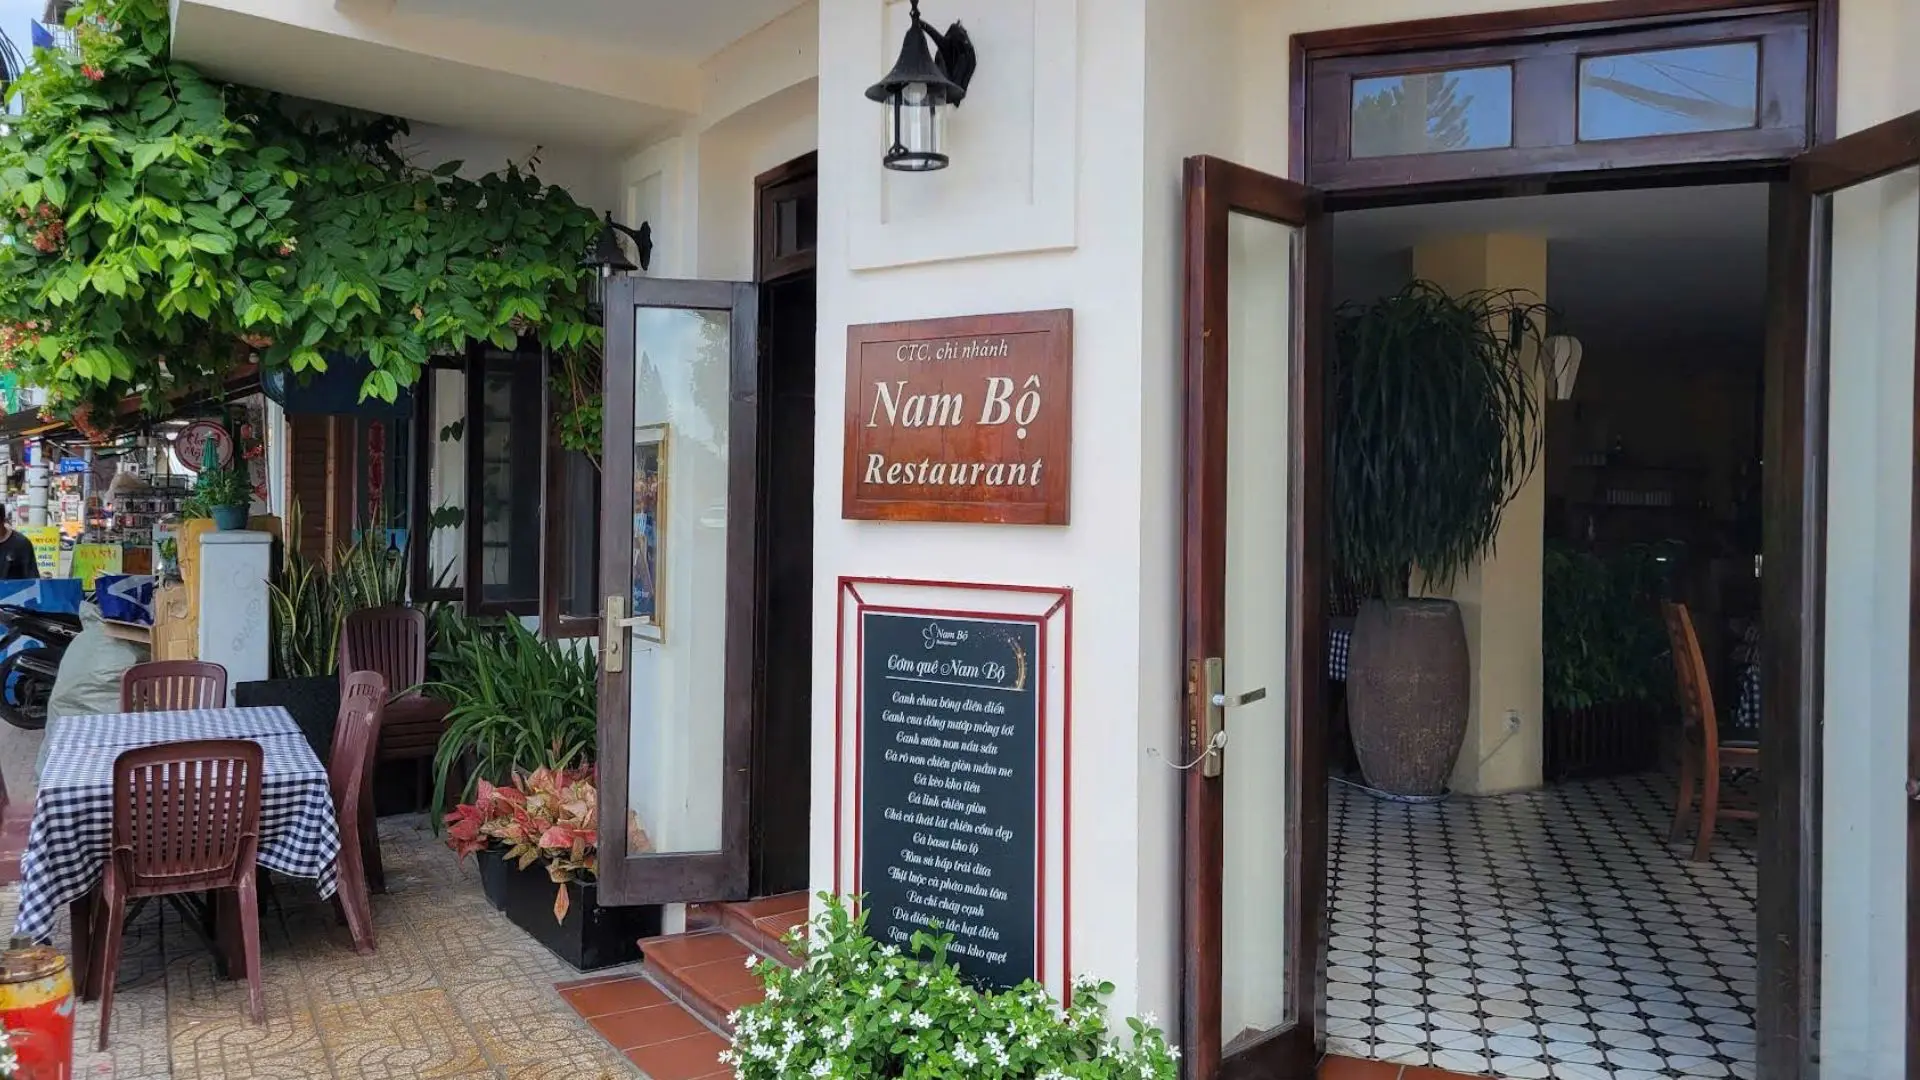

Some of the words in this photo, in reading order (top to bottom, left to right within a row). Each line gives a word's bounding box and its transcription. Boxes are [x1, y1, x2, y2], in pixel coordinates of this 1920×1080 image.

[897, 343, 932, 362] CTC,
[936, 342, 958, 360] chi
[962, 339, 1008, 358] nhánh
[866, 380, 964, 428] Nam
[977, 374, 1041, 439] Bộ
[864, 454, 1042, 486] Restaurant
[937, 628, 955, 639] Nam
[888, 654, 914, 671] Cơm
[916, 660, 938, 676] quê
[941, 659, 979, 678] Nam
[982, 662, 1005, 683] Bộ
[892, 691, 915, 705] Canh
[916, 695, 937, 707] chua
[939, 697, 961, 713] bông
[882, 710, 905, 723] Canh
[906, 714, 921, 725] cua
[896, 731, 919, 745] Canh
[943, 741, 959, 750] non
[885, 749, 897, 762] Cá
[910, 755, 925, 765] non
[927, 756, 950, 769] chiên
[998, 768, 1013, 777] me
[914, 773, 926, 785] Cá
[928, 775, 943, 786] kèo
[945, 778, 961, 790] kho
[908, 791, 920, 804] Cá
[922, 794, 939, 807] linh
[941, 798, 964, 811] chiên
[904, 811, 914, 823] cá
[950, 818, 973, 833] chiên
[913, 832, 926, 845] Cá
[928, 834, 950, 848] basa
[951, 838, 968, 852] kho
[969, 842, 979, 856] tộ
[906, 890, 923, 903] Ba
[892, 907, 909, 921] Đà
[888, 925, 908, 943] Rau
[968, 943, 984, 958] kho
